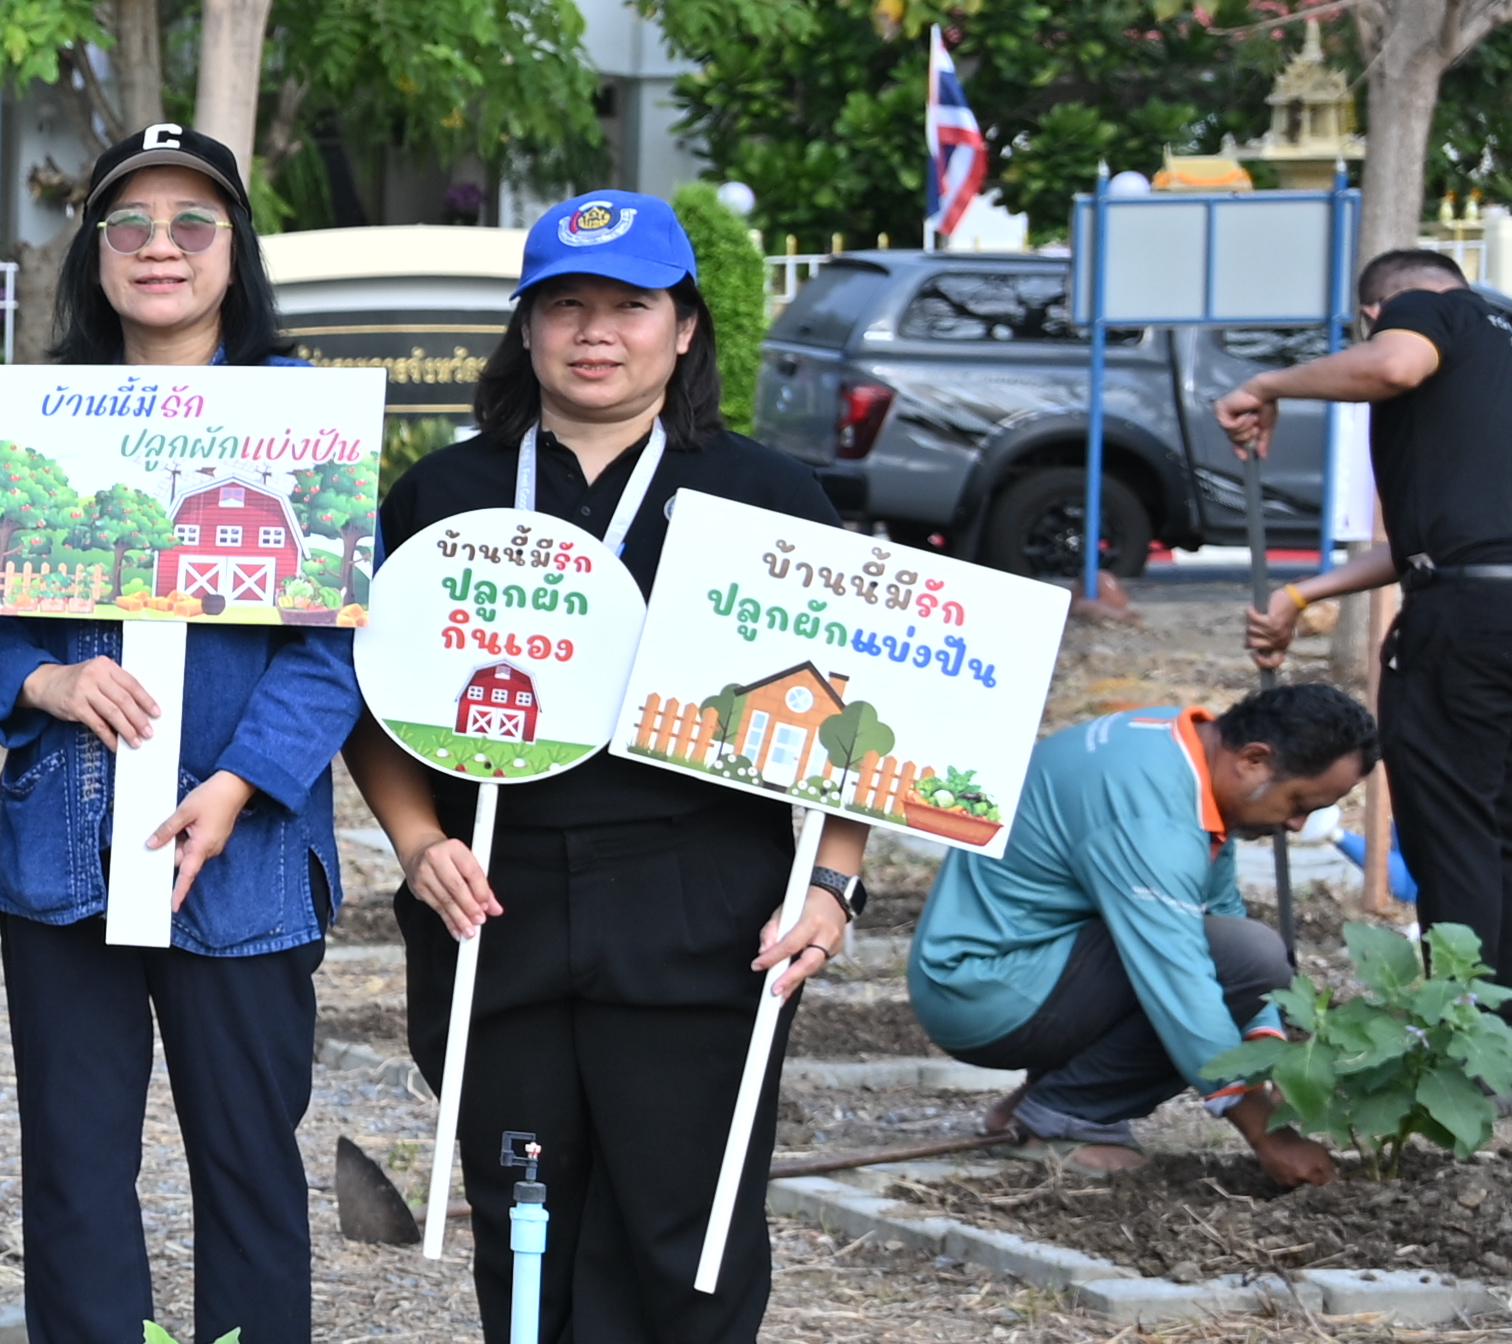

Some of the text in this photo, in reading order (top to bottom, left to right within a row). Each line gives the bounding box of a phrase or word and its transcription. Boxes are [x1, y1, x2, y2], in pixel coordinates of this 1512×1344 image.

[120, 426, 360, 472] ปลูกผักแบ่งปัน
[437, 525, 592, 573] บ้านนี้มีรัก
[442, 568, 588, 622] ปลูกผัก
[763, 539, 964, 626] บ้านนี้มีรัก
[441, 609, 574, 662] กินเอง
[707, 583, 996, 688] ปลูกผักแบ่งปัน
